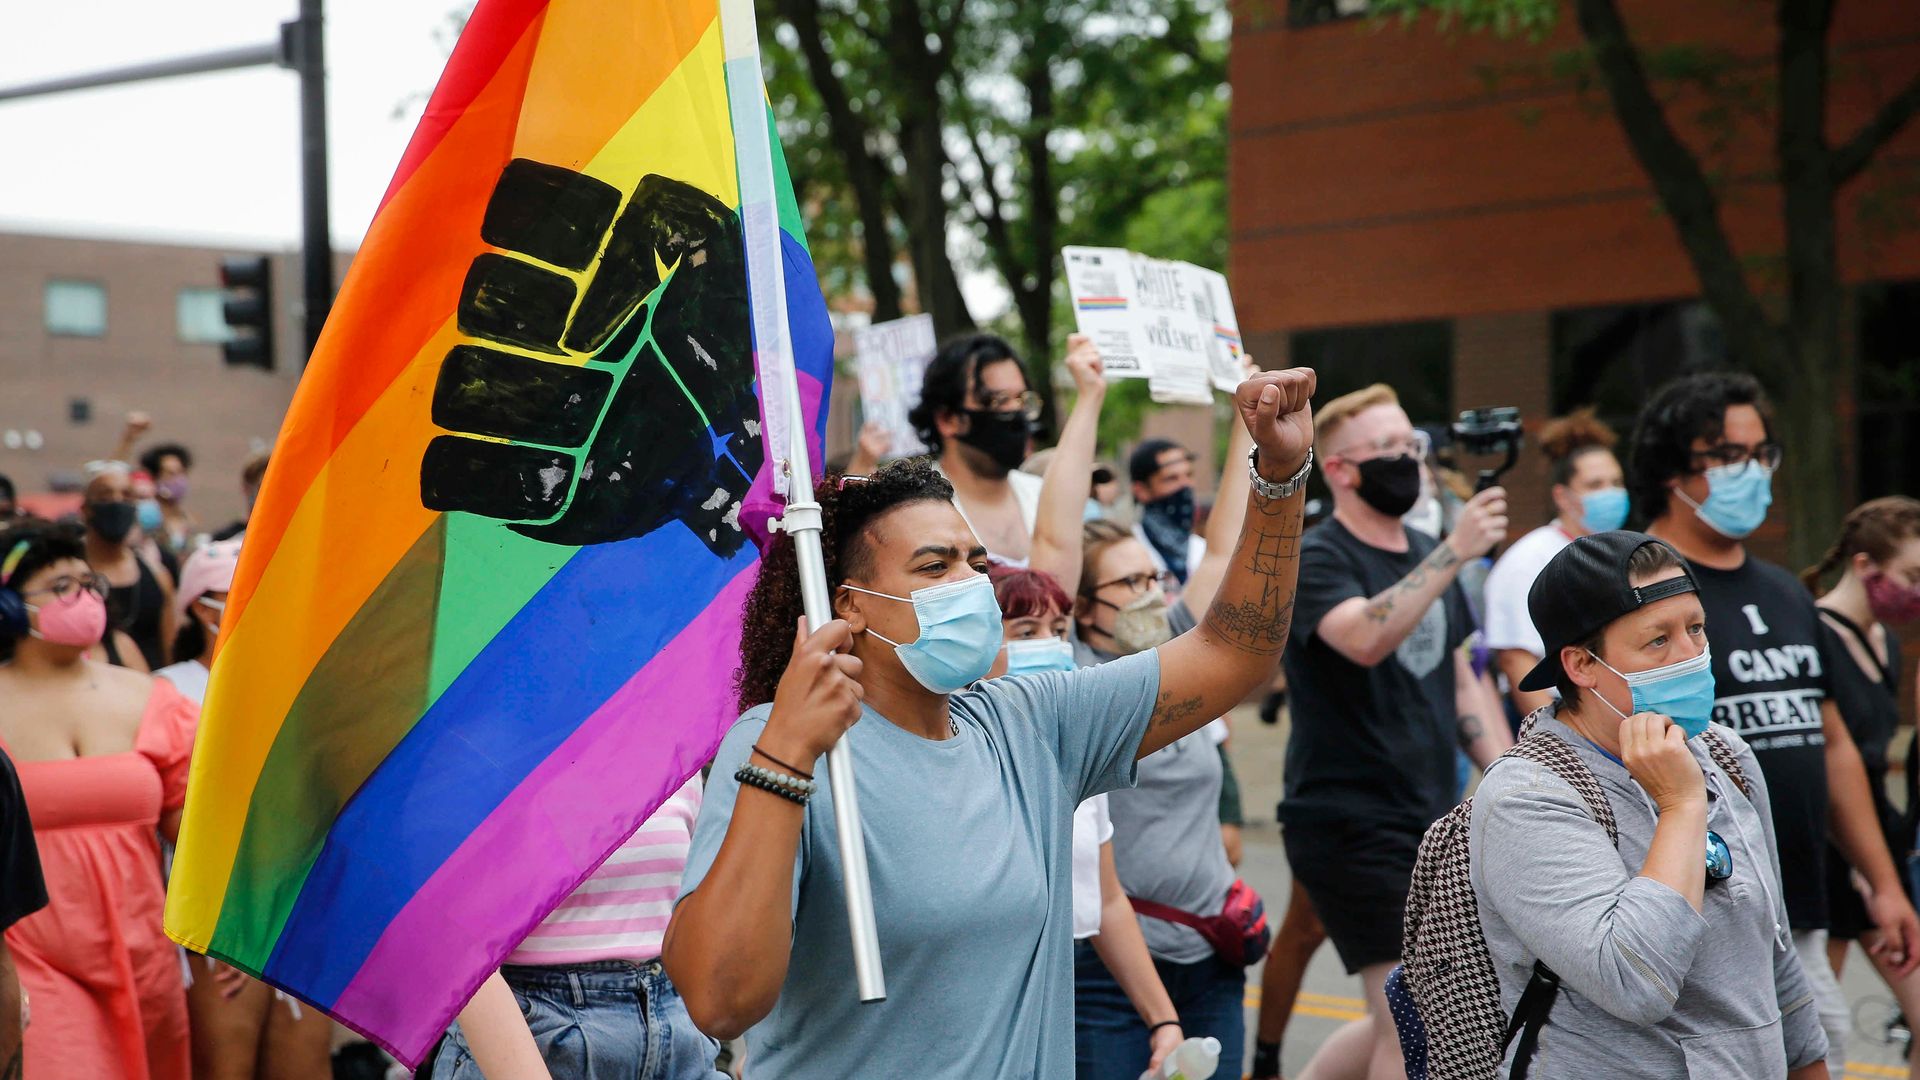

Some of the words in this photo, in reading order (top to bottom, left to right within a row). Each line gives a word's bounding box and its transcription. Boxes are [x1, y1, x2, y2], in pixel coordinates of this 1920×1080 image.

[1129, 262, 1185, 299] WHITE
[1741, 604, 1770, 635] I
[1728, 644, 1823, 683] CAN'T
